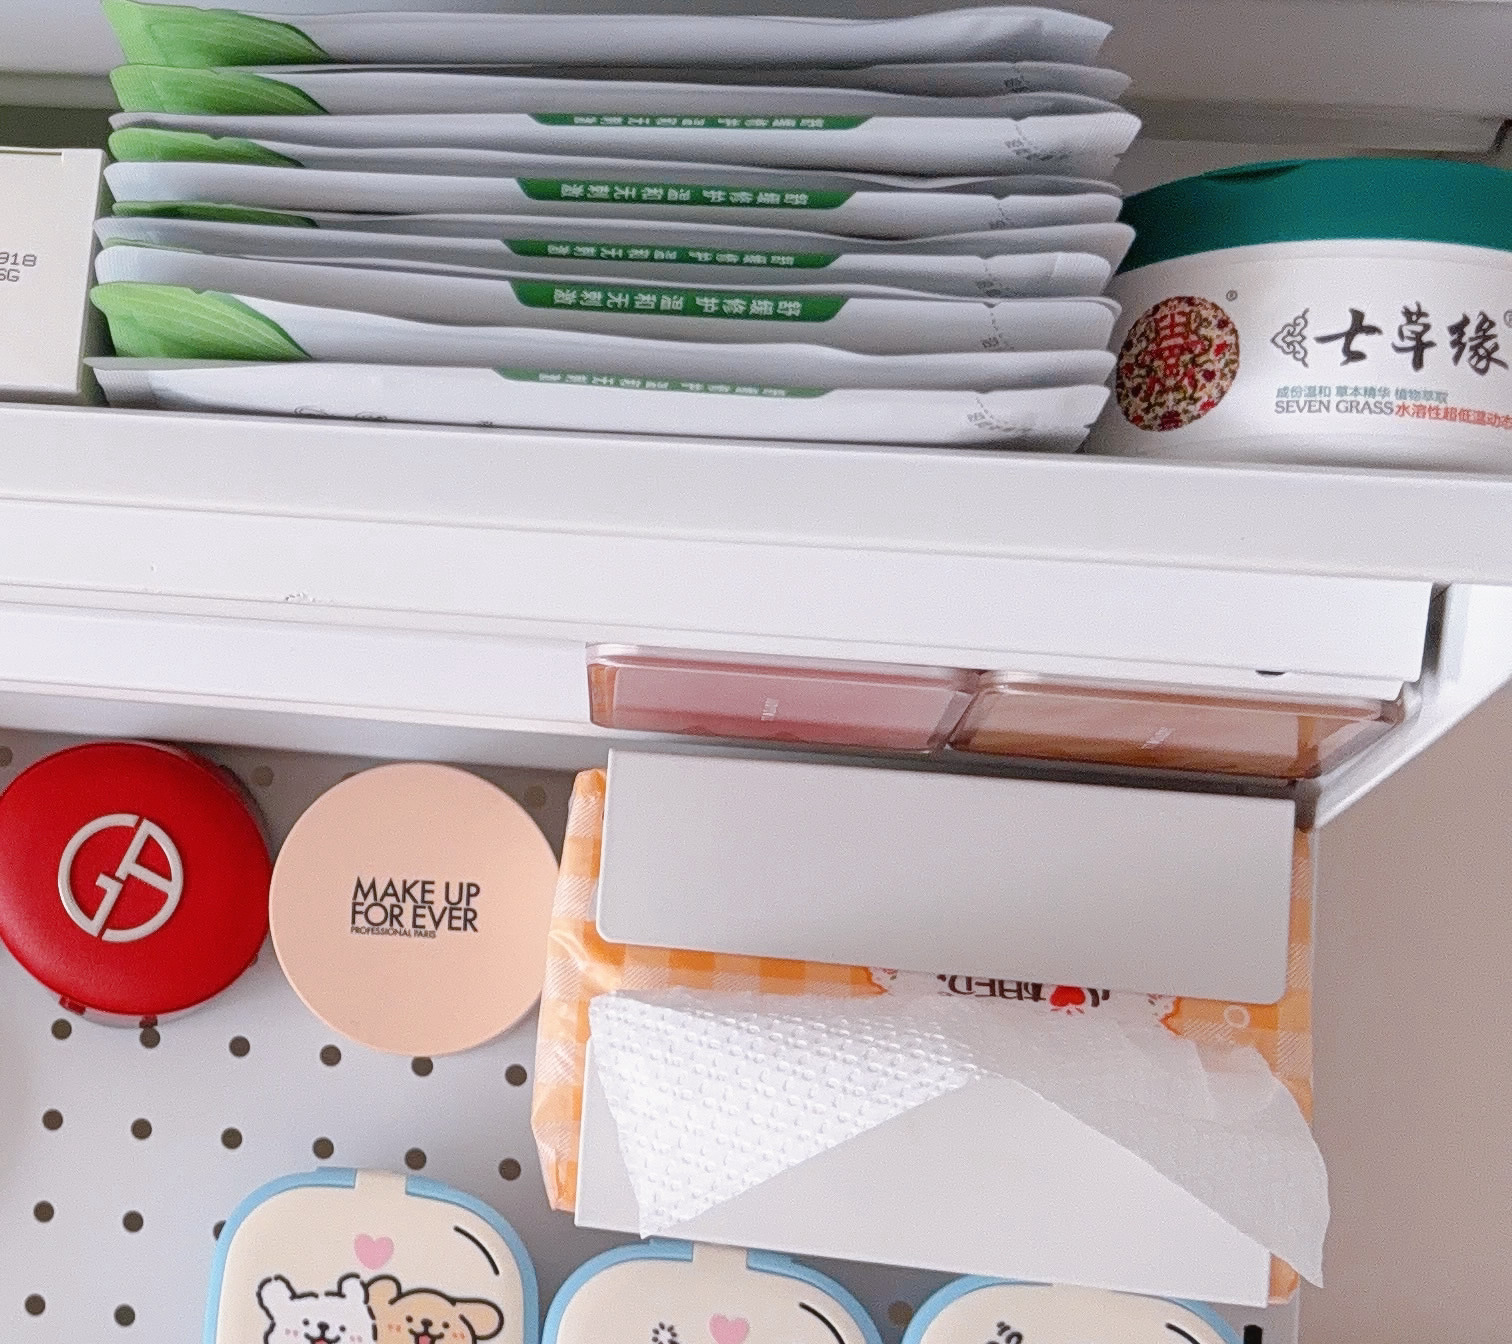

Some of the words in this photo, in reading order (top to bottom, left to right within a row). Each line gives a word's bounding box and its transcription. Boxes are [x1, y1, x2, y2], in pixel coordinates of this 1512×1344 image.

[702, 189, 809, 206] 舒缓修护
[554, 288, 684, 311] 温和无刺激
[696, 296, 802, 316] 舒缓修护
[1314, 301, 1510, 376] 七草缘
[1276, 385, 1331, 399] 成份温和
[1335, 386, 1391, 400] 草本精华
[1274, 399, 1332, 414] SEVEN
[1335, 400, 1394, 416] GRASS
[352, 876, 435, 904] MAKE
[445, 881, 480, 906] UP
[351, 901, 404, 928] FOR
[412, 904, 478, 932] EVER
[351, 926, 411, 937] PROFESSIONAL
[414, 929, 436, 939] PARIS
